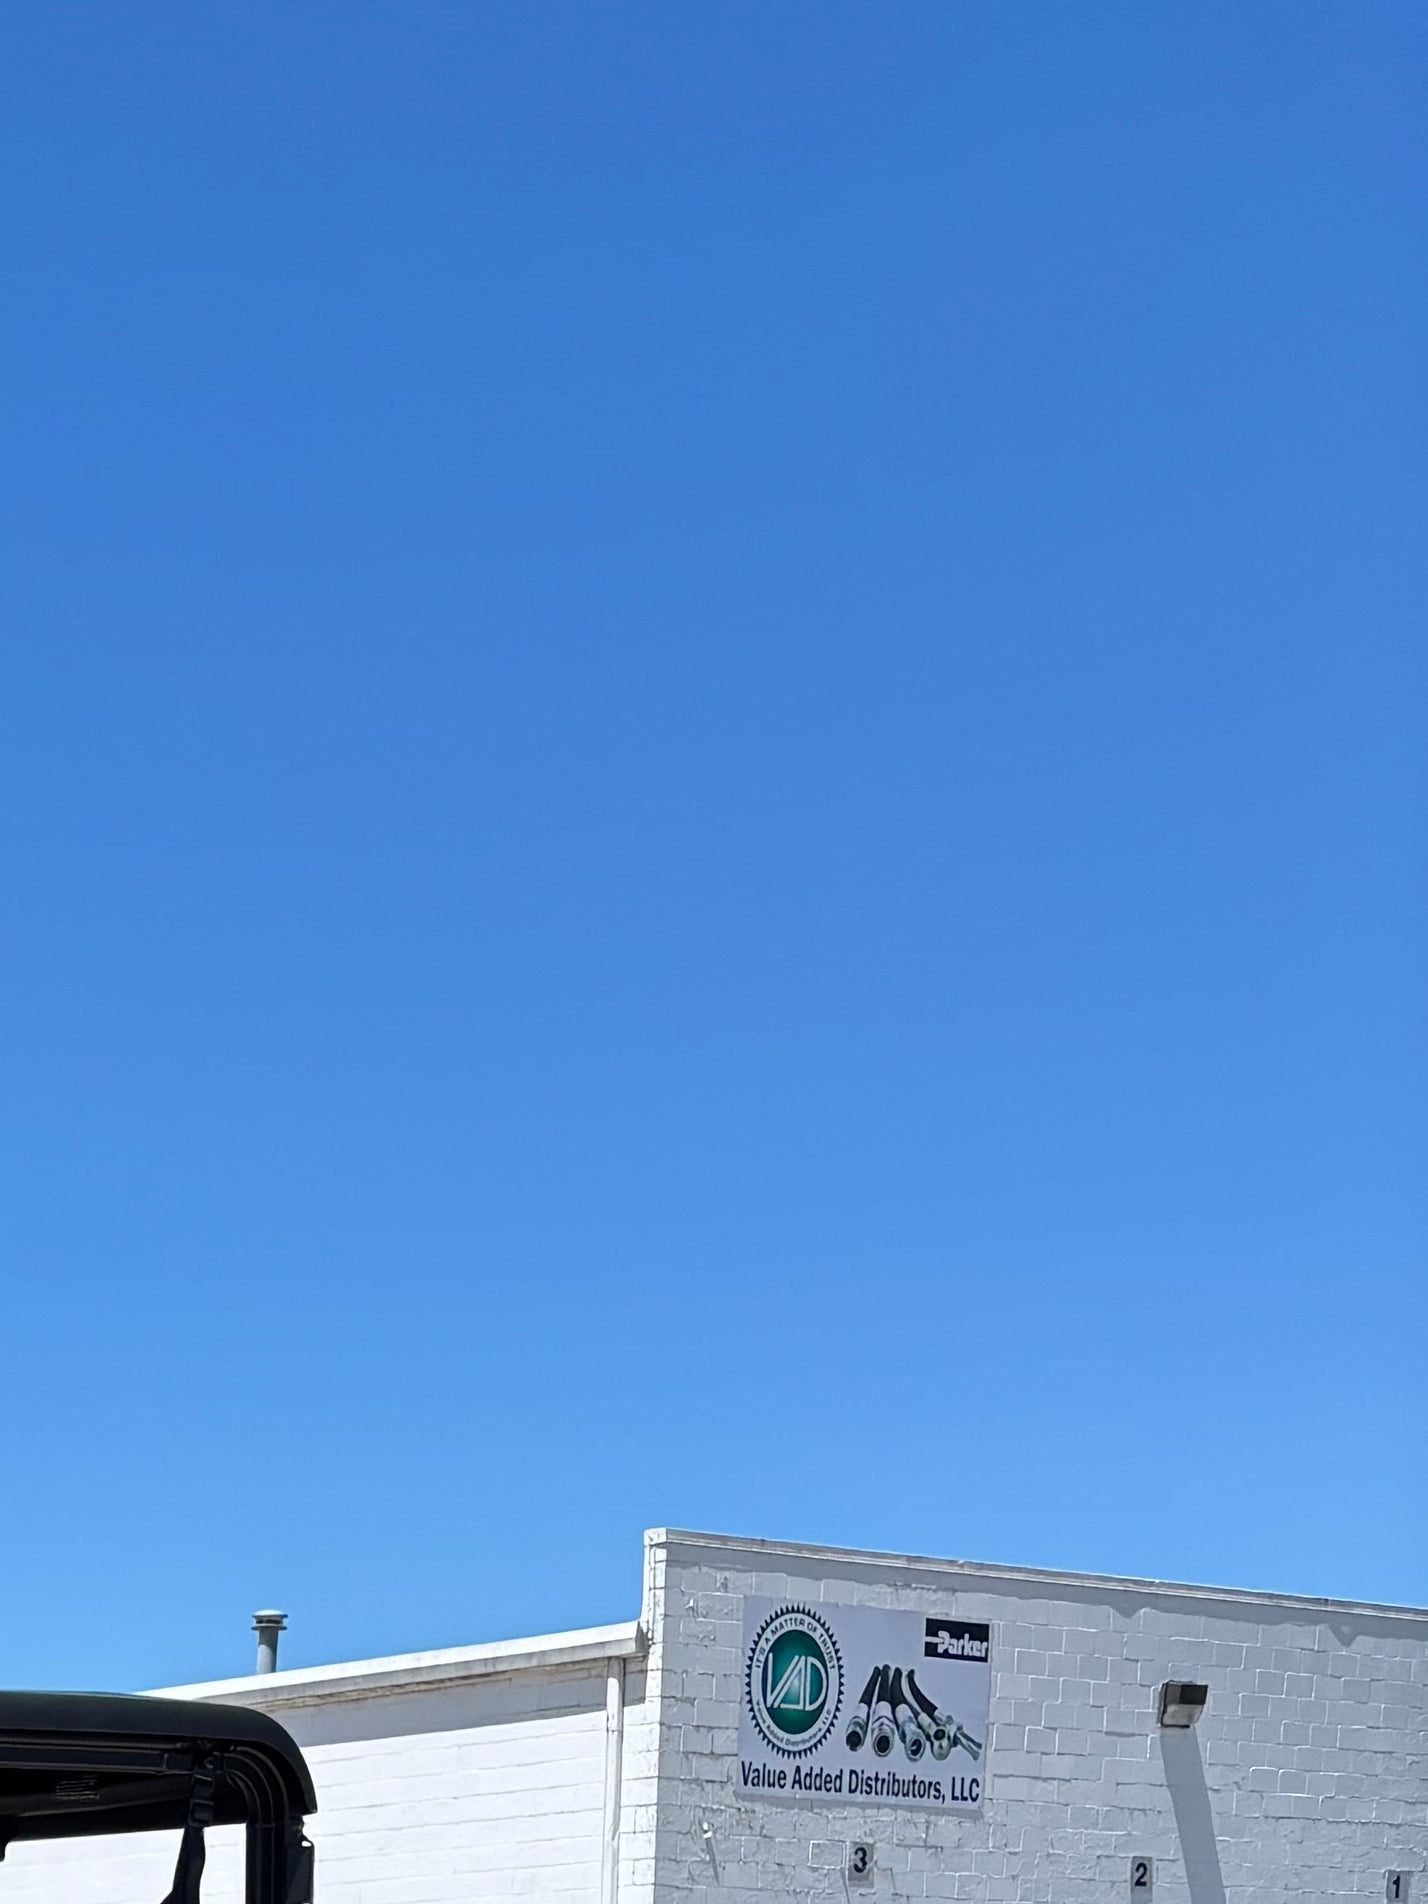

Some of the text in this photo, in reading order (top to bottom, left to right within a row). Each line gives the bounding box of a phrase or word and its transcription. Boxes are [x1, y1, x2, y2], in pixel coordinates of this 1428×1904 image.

[770, 1617, 805, 1637] MATTER
[937, 1630, 988, 1658] Parker
[766, 1652, 827, 1711] VAD
[741, 1760, 980, 1804] Value Added Distributors, LLC
[854, 1847, 867, 1873] 3
[1134, 1862, 1148, 1887] 2
[1392, 1874, 1401, 1899] 1
